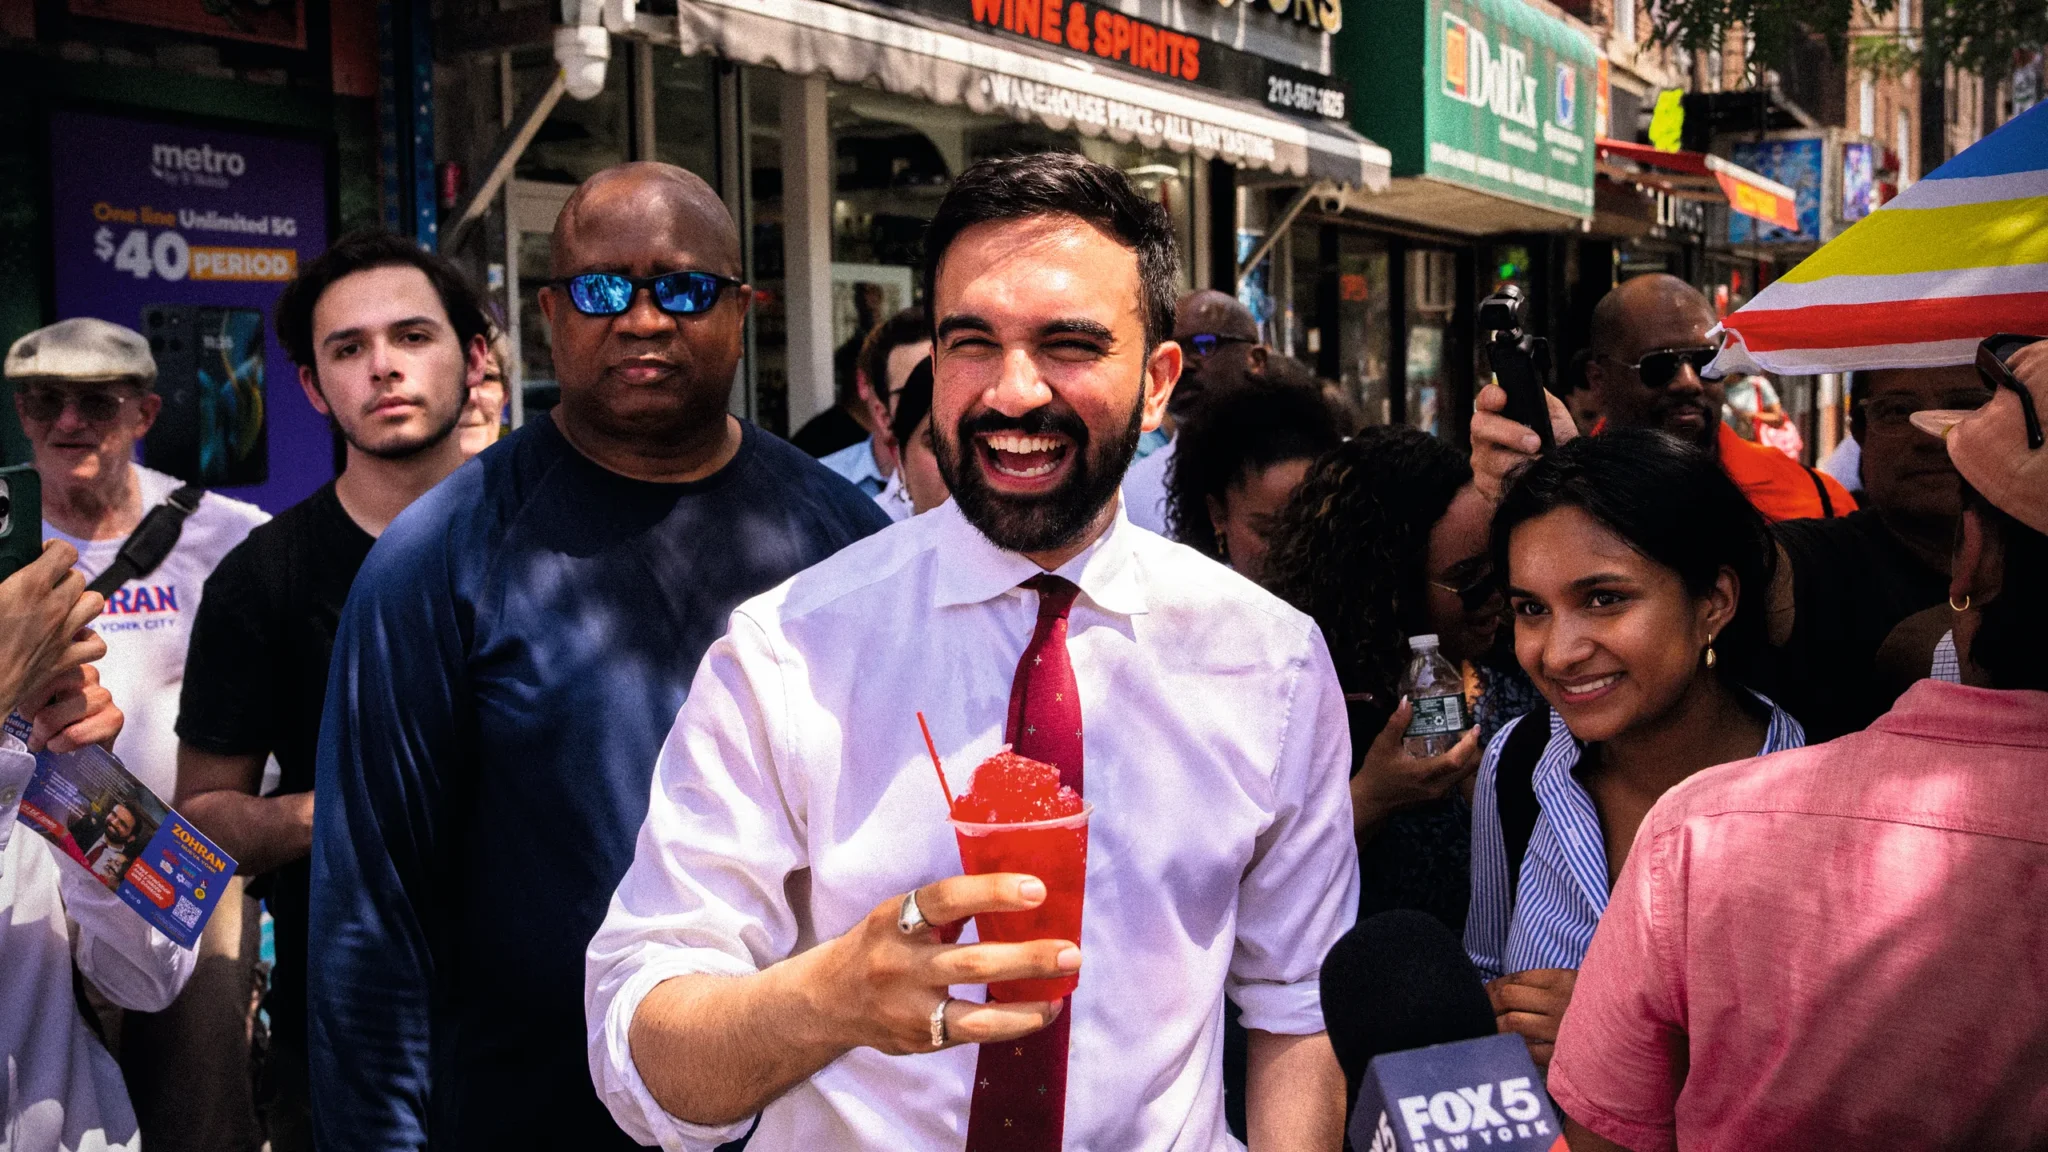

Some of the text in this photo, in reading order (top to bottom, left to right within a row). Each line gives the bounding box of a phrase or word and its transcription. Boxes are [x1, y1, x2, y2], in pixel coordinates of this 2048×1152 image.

[972, 0, 1062, 44] WINE
[1066, 2, 1090, 52] &
[1094, 10, 1200, 81] SPIRITS
[1468, 26, 1538, 129] DolEx
[989, 73, 1107, 126] WAREHOUSE
[1107, 100, 1156, 136] PRICE
[1163, 113, 1193, 145] ALL
[1221, 129, 1276, 161] TASTING
[152, 143, 246, 177] metro
[93, 202, 297, 237] One line Unlimited 5G
[94, 226, 190, 281] $40
[101, 585, 179, 615] RAN
[100, 622, 140, 632] YORK
[144, 619, 175, 630] CITY
[170, 821, 227, 872] ZOHRAN
[1413, 1119, 1551, 1152] NEW YORK
